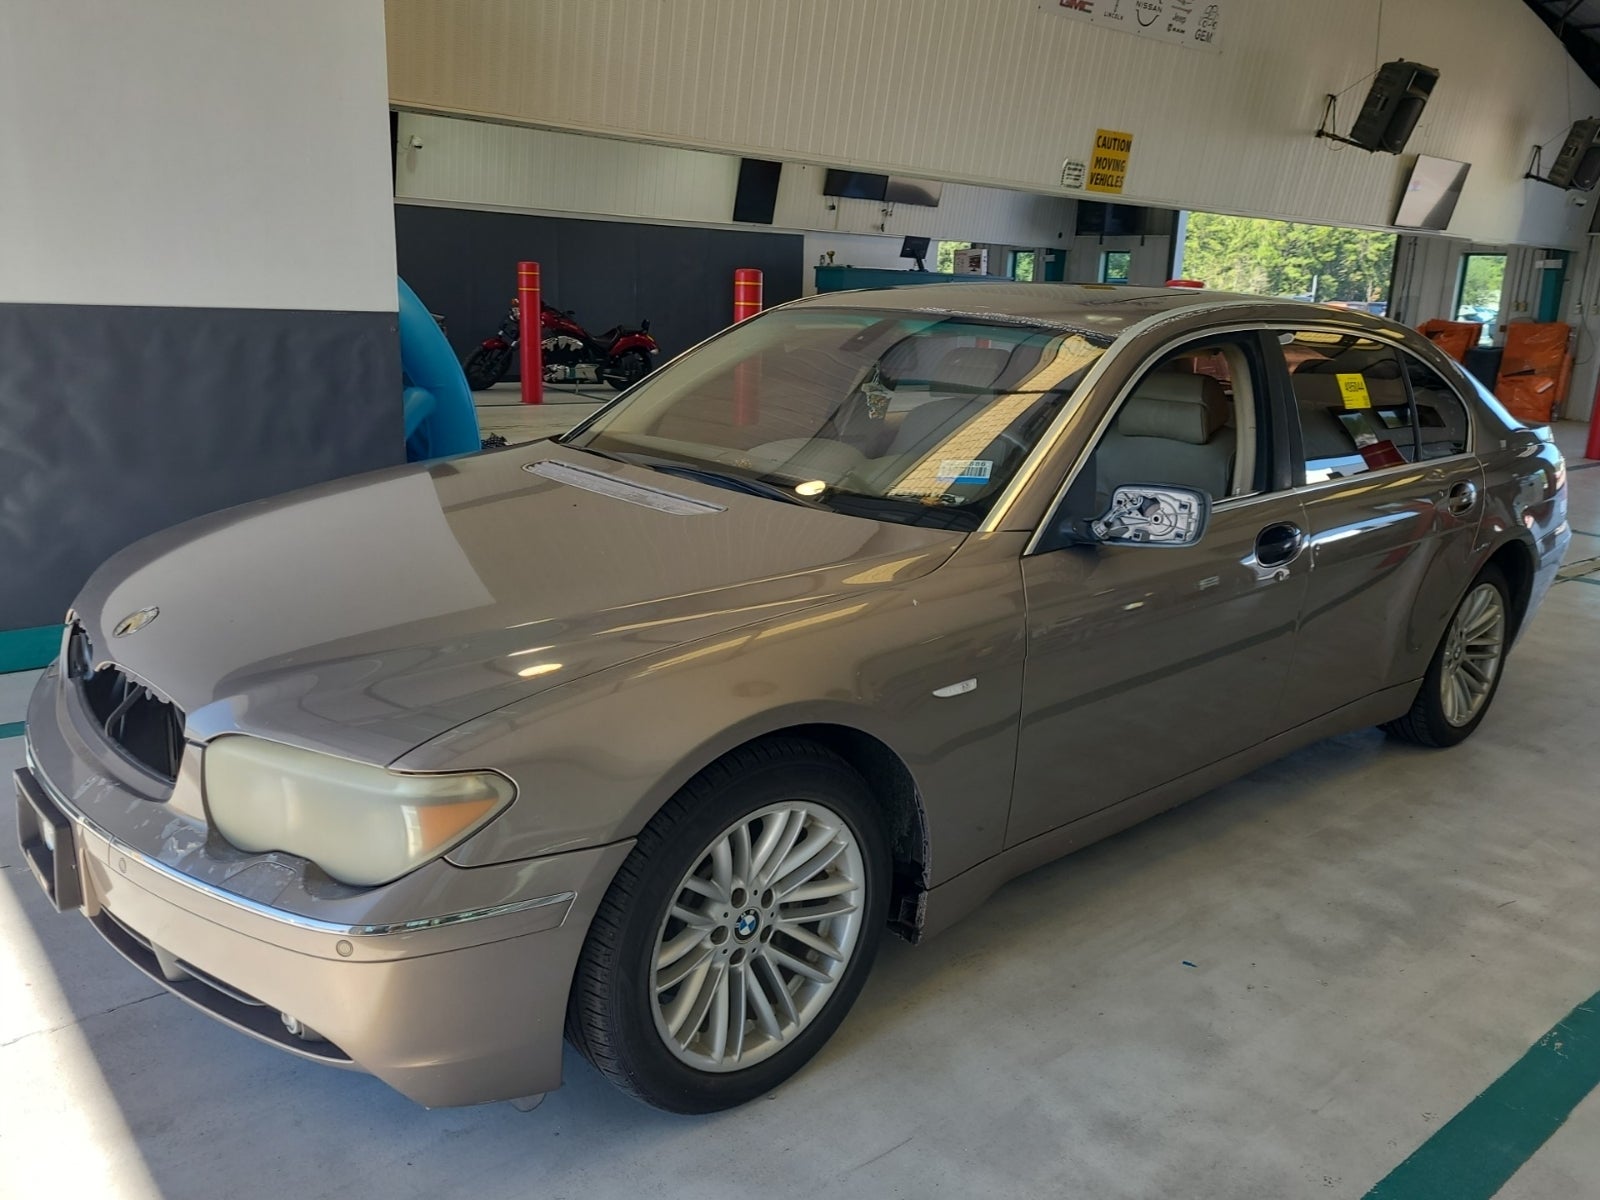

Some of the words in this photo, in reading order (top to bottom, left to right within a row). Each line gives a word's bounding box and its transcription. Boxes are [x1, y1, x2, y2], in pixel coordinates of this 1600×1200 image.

[1136, 1, 1162, 13] NISSAN
[1096, 135, 1132, 153] CAUTION
[1094, 156, 1126, 172] MOVING
[1089, 172, 1124, 188] VEHICLES
